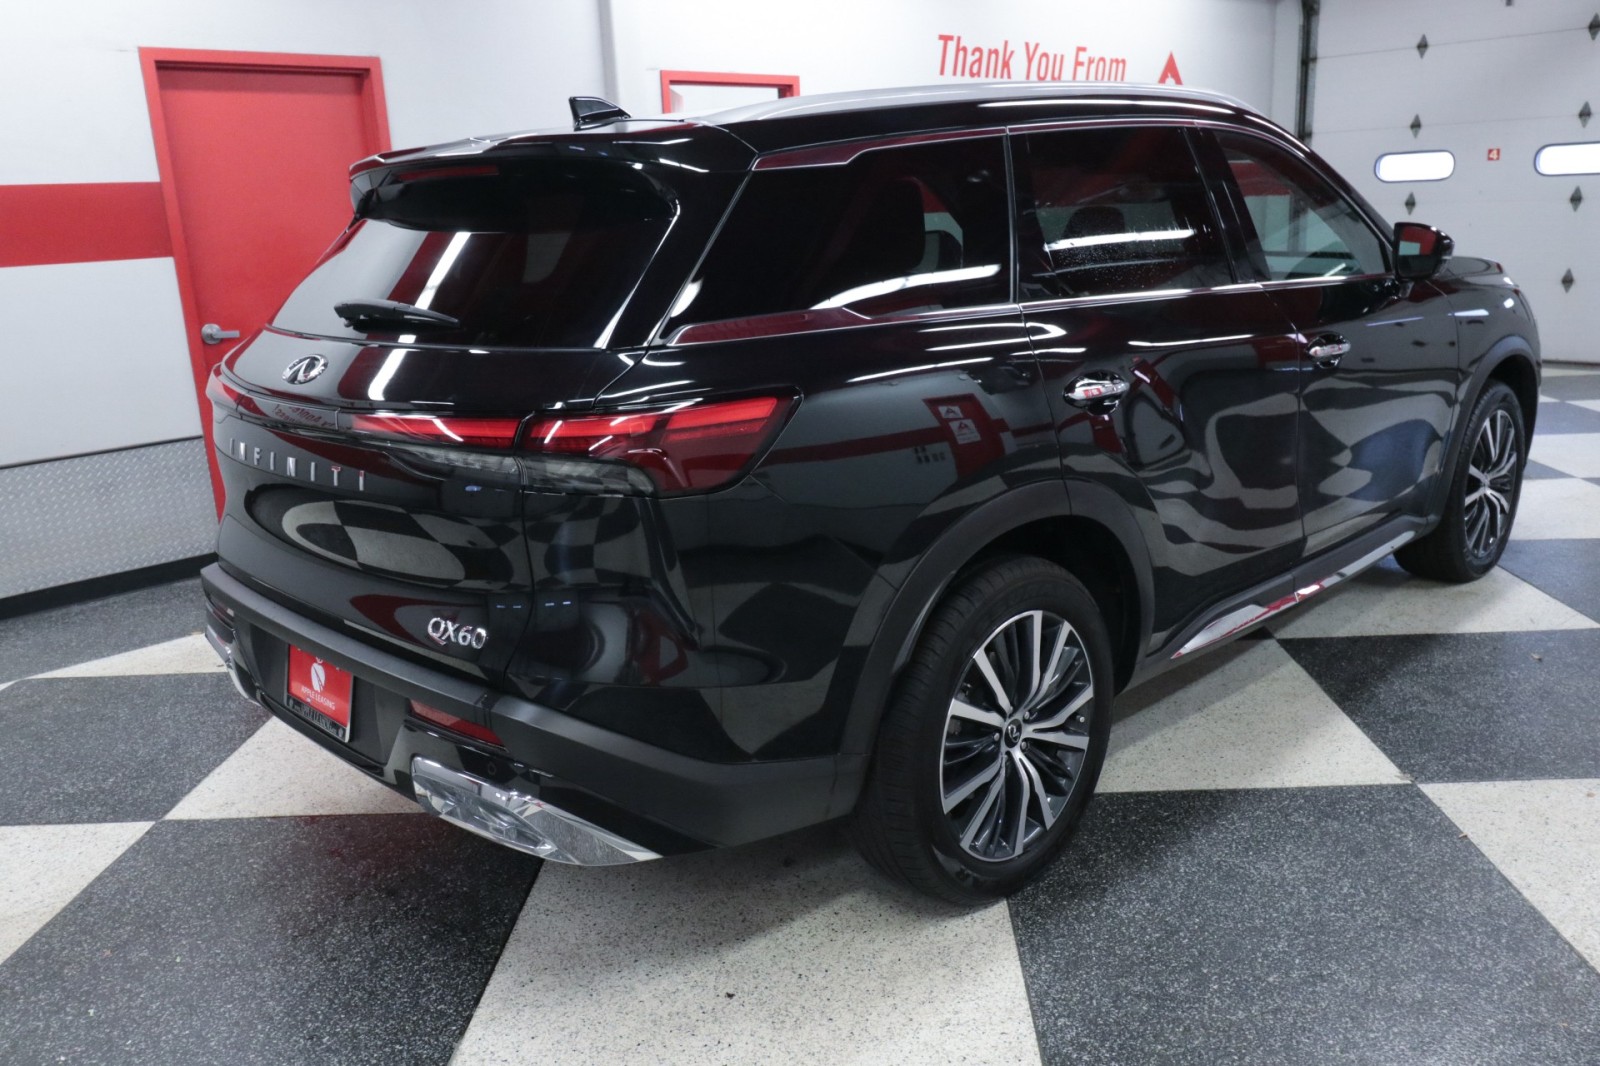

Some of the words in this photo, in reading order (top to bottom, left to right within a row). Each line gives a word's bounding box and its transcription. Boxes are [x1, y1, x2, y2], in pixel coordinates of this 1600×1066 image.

[938, 34, 1014, 80] Thank
[1024, 41, 1064, 81] You
[1073, 46, 1126, 81] From
[1489, 149, 1498, 160] 4
[230, 438, 365, 491] INFINITI
[427, 617, 487, 649] QX60
[301, 685, 315, 698] APPLE
[315, 694, 336, 711] LEASING
